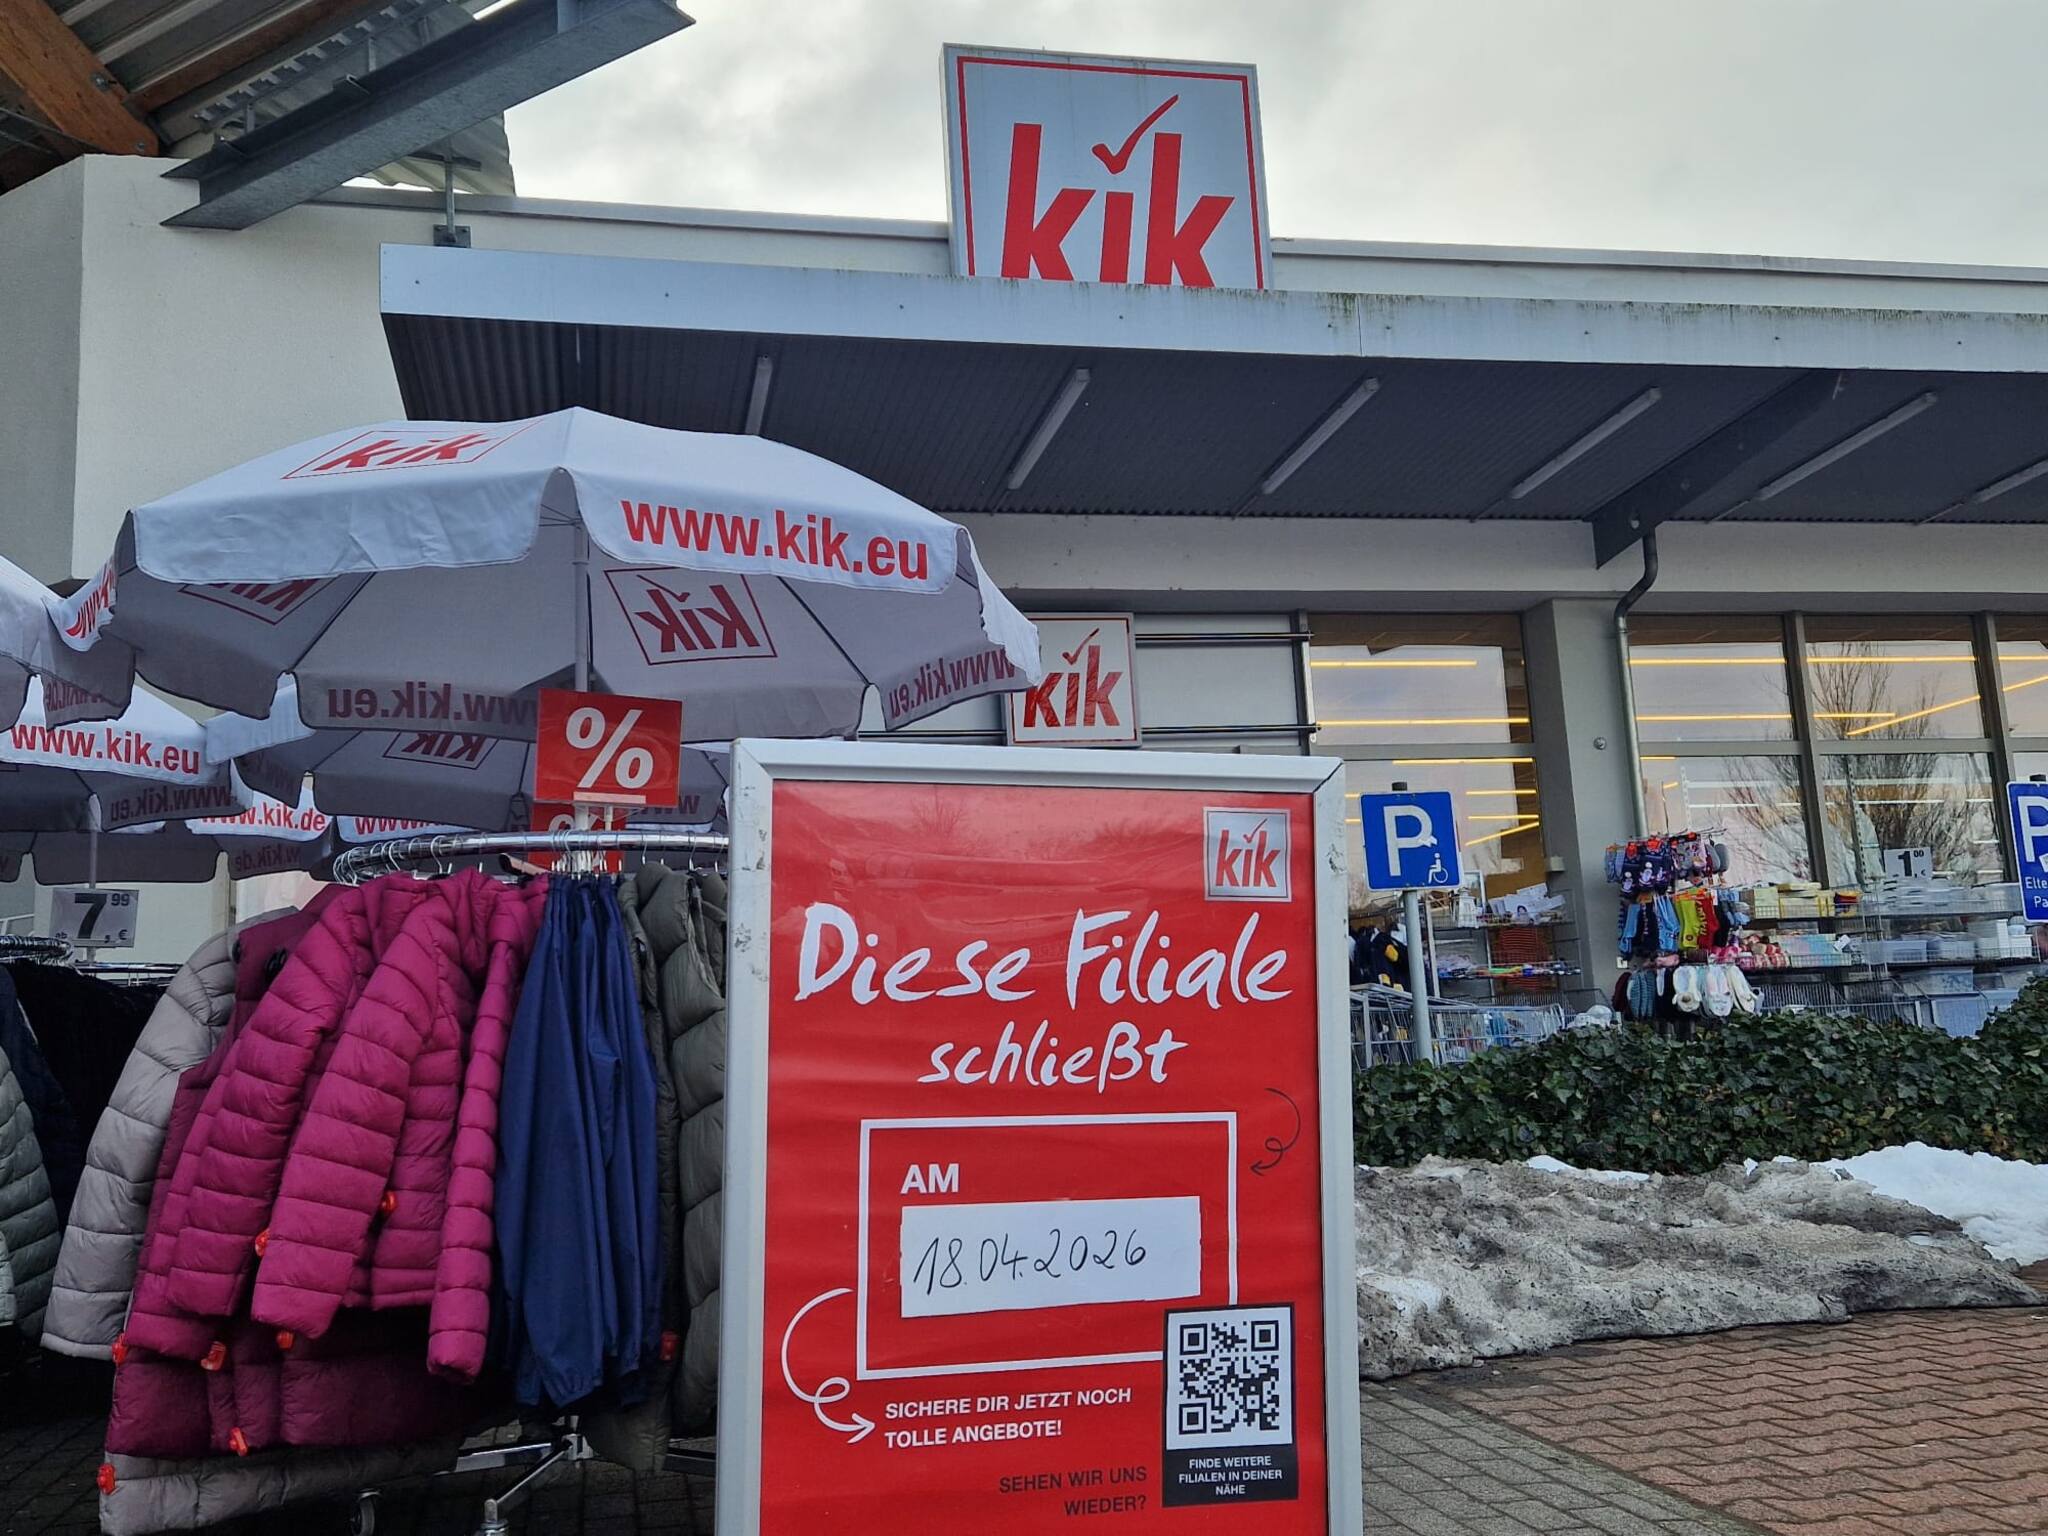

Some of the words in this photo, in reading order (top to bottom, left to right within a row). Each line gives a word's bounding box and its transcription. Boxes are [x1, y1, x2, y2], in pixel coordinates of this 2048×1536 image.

[1001, 122, 1236, 288] kik
[312, 433, 490, 471] kik
[621, 500, 929, 580] www.kik.eu
[1023, 644, 1123, 728] kik
[11, 724, 200, 775] www.kik.eu
[565, 707, 654, 789] %
[1383, 805, 1434, 877] P
[2017, 796, 2048, 862] P
[1216, 829, 1281, 888] kik
[794, 902, 1036, 1005] Diese
[1066, 908, 1292, 1010] Filiale
[917, 1019, 1189, 1093] schließt
[900, 1163, 960, 1194] AM
[885, 1398, 971, 1419] SICHERE
[976, 1396, 1009, 1413] DIR
[1014, 1391, 1072, 1410] JETZT
[1077, 1387, 1132, 1406] NOCH
[885, 1428, 947, 1449] TOLLE
[952, 1419, 1062, 1443] ANGEBOTE!
[999, 1473, 1062, 1494] SEHEN
[1068, 1470, 1104, 1488] WIR
[1109, 1466, 1147, 1484] UNS
[1179, 1472, 1226, 1484] FILIALEN
[1228, 1471, 1240, 1481] IN
[1242, 1469, 1283, 1480] DEINER
[1189, 1458, 1221, 1469] FINDE
[1223, 1455, 1272, 1468] WEITERE
[1065, 1495, 1147, 1516] WIEDER?
[1215, 1484, 1246, 1495] NÄHE
